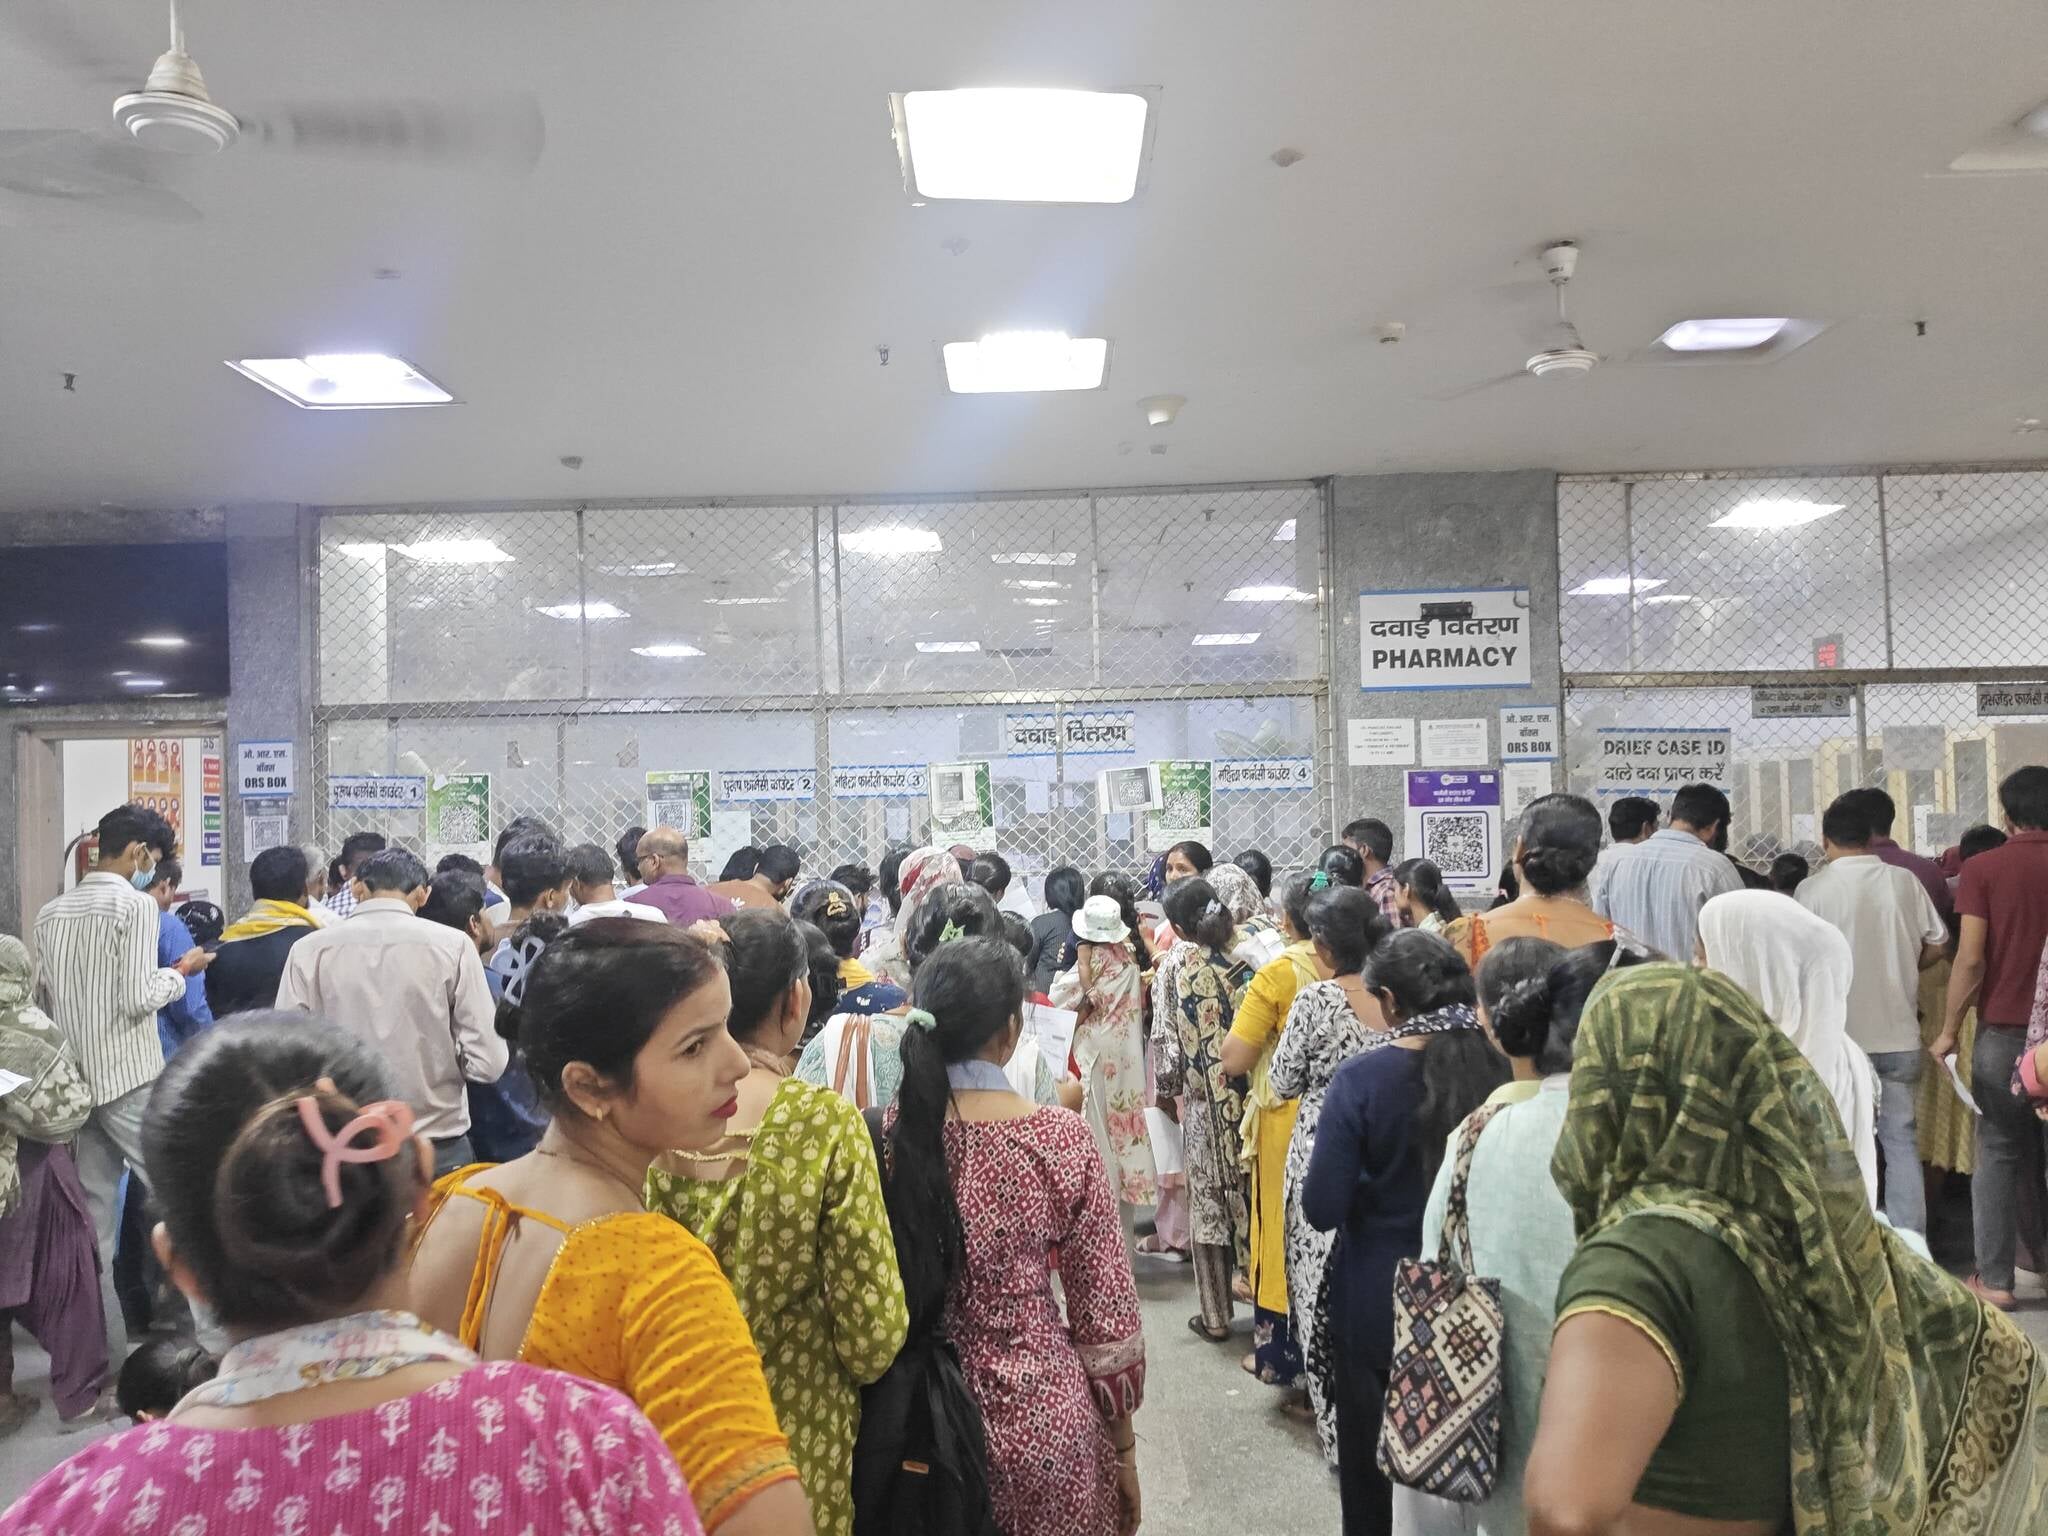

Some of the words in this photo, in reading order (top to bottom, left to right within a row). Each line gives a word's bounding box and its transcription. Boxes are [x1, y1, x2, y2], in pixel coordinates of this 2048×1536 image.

[1372, 646, 1517, 669] PHARMACY
[1065, 720, 1129, 742] वितरण
[1507, 742, 1528, 753] ORS
[1531, 741, 1552, 753] BOX
[1657, 740, 1701, 755] CASE
[1708, 740, 1725, 755] ID
[1297, 767, 1307, 778] 4
[1604, 762, 1633, 781] वाले
[1636, 766, 1660, 781] दवा
[1664, 766, 1695, 783] प्राप्त
[244, 777, 265, 789] ORS
[267, 776, 287, 788] BOX
[802, 778, 812, 790] 2
[912, 775, 920, 786] 3
[409, 787, 417, 797] 1
